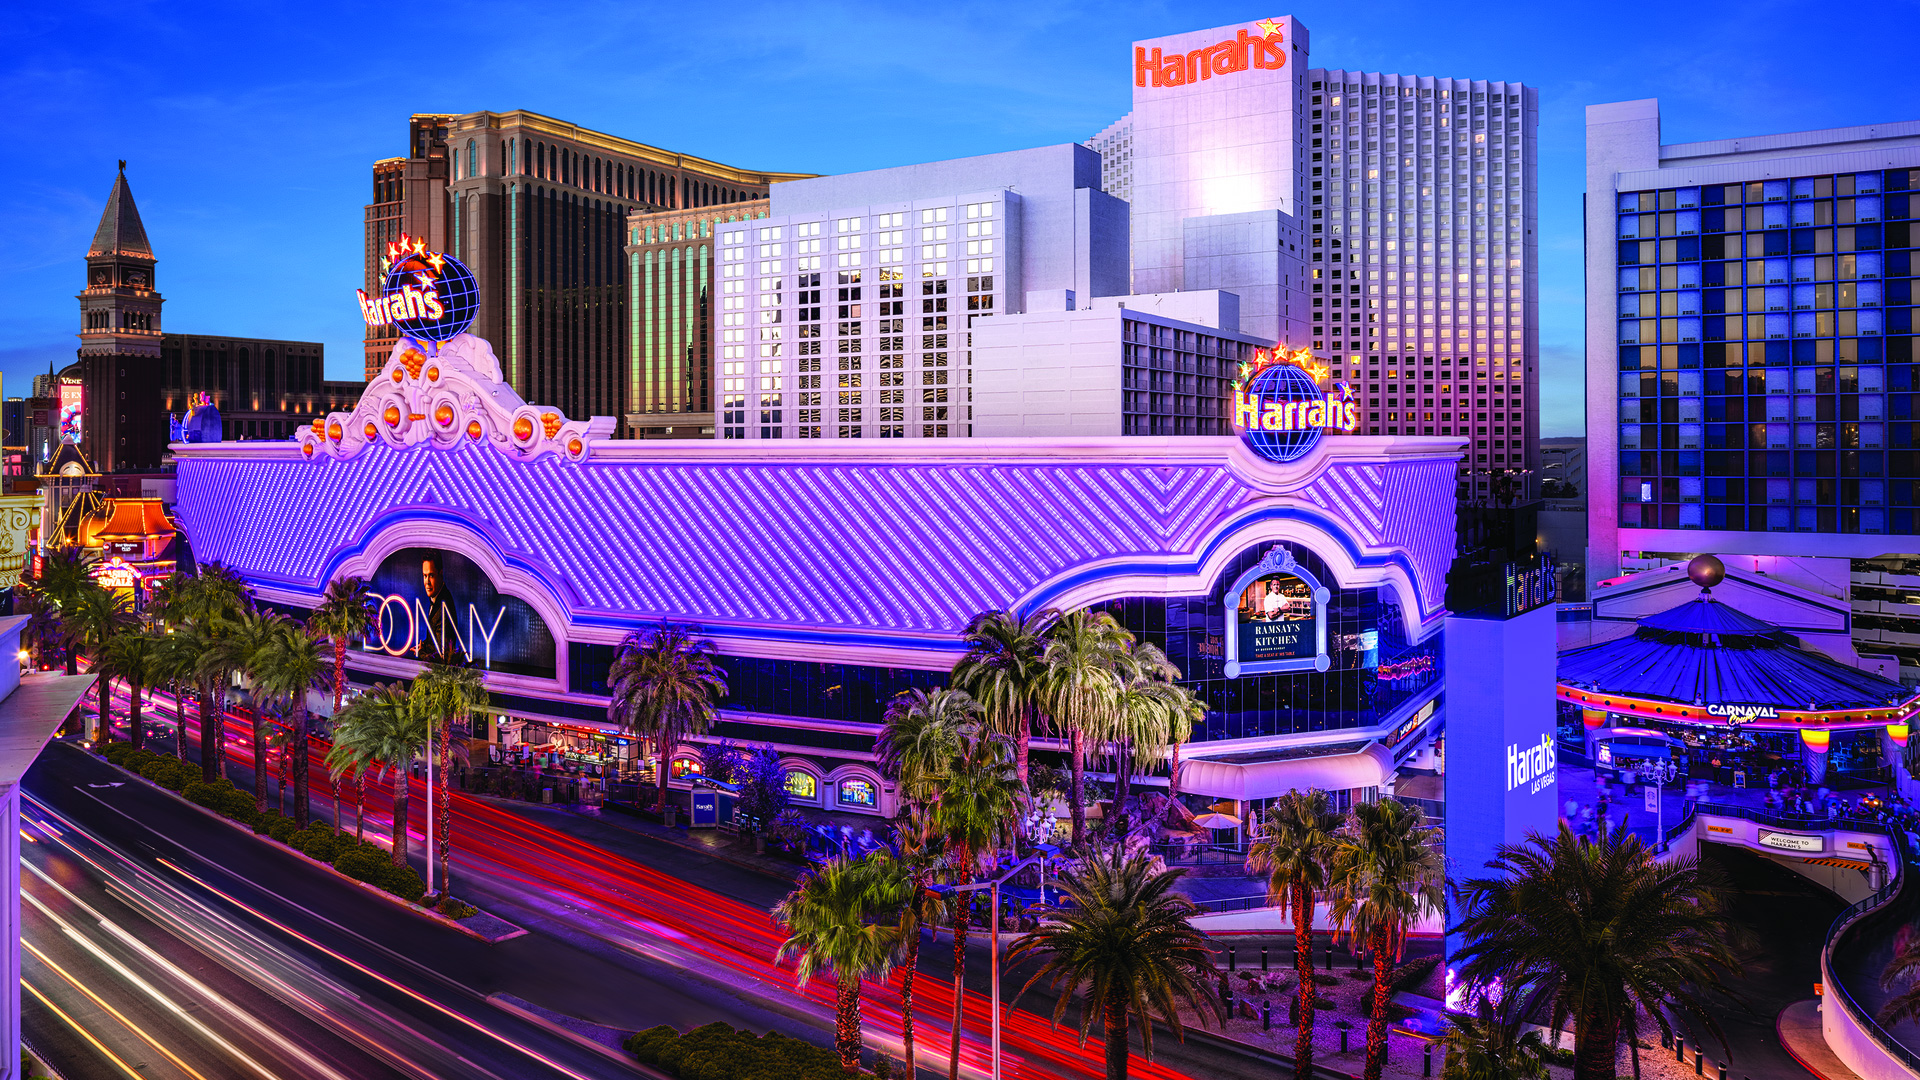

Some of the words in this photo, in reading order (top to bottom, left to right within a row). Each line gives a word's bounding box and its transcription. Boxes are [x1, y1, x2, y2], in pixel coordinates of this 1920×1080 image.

[363, 592, 506, 669] DONNY
[1255, 623, 1301, 635] RAMSAY'S
[1255, 635, 1298, 647] KITCHEN
[1708, 704, 1778, 718] CARNAVAL
[1531, 778, 1541, 795] LAS
[1540, 771, 1555, 789] VEGAS
[1770, 836, 1800, 845] WELCOME
